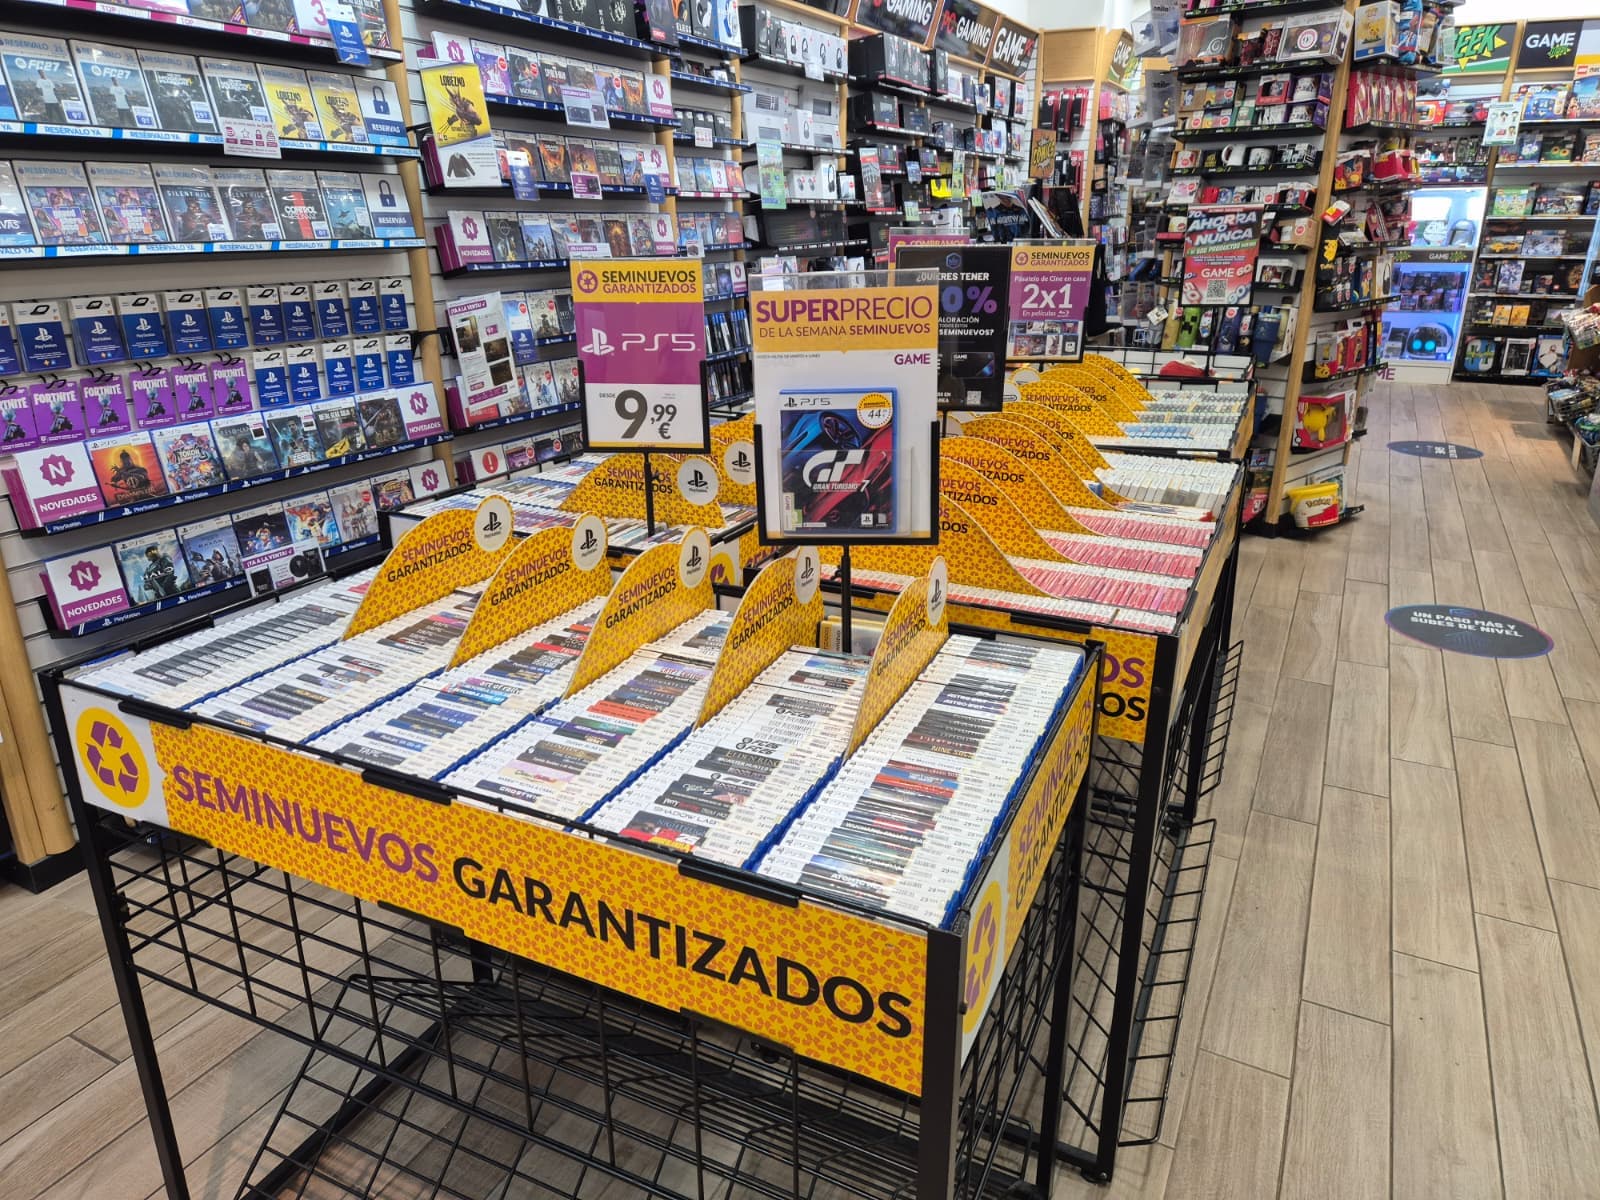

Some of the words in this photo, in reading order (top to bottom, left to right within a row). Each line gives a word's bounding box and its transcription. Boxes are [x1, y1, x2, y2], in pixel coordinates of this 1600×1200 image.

[886, 0, 933, 26] GAMING
[942, 11, 957, 33] PC
[956, 18, 992, 47] GAMING
[993, 27, 1025, 65] GAME
[1455, 25, 1502, 59] EEK
[1526, 32, 1576, 48] GAME
[27, 59, 61, 72] FC27
[102, 67, 131, 80] FC27
[440, 74, 465, 87] LOBEZNO
[92, 128, 102, 136] YA
[371, 123, 400, 134] RESERVAS
[1033, 142, 1055, 166] COMICS
[378, 216, 406, 224] RESERVAS
[1188, 212, 1257, 232] AHORRA
[1217, 224, 1228, 232] O
[1195, 228, 1253, 245] NUNCA
[461, 249, 490, 257] NOVEDADES
[1031, 251, 1090, 260] SEMINUEVOS
[602, 270, 696, 283] SEMINUEVOS
[916, 272, 958, 283] ¿QUIERES
[960, 272, 990, 281] TENER
[1201, 267, 1235, 278] GAME
[603, 283, 697, 294] GARANTIZADOS
[1021, 283, 1073, 309] 2x1
[941, 285, 998, 314] 0%
[756, 295, 933, 323] SUPERPRECIO
[759, 327, 776, 338] DE
[778, 326, 794, 337] LA
[796, 325, 848, 337] SEMANA
[849, 323, 931, 336] SEMINUEVOS
[939, 328, 995, 336] SEMINUEVOS?
[621, 332, 696, 352] PS5
[894, 353, 931, 366] GAME
[175, 372, 208, 386] FORTNITE
[214, 366, 246, 379] FORTNITE
[84, 383, 122, 398] FORTNITE
[133, 377, 169, 391] FORTNITE
[34, 389, 77, 404] FORTNITE
[800, 397, 831, 406] PS5
[1025, 393, 1079, 403] SEMINUEVOS
[409, 422, 441, 433] NOVEDADES
[49, 461, 67, 480] N
[594, 477, 673, 494] GARANTIZDOS
[831, 482, 858, 490] TURISMO
[860, 480, 870, 492] 7
[40, 492, 98, 513] NOVEDADES
[184, 491, 209, 502] PlayStation
[134, 502, 160, 513] PlayStation
[53, 521, 81, 530] PlayStation
[401, 527, 470, 563] SEMINUEVOS
[387, 540, 473, 583] GARANTIZADOS
[504, 548, 569, 584] SEMINUEVOS
[76, 566, 94, 585] N
[141, 566, 173, 581] HALO
[491, 560, 570, 606] GARANTIZADOS
[618, 565, 676, 608] SEMINUEVOS
[188, 589, 211, 600] PlayStation
[743, 580, 792, 624] SEMINUEVOS
[67, 594, 122, 618] NOVEDADES
[605, 580, 677, 630] GARANTIZADOS
[114, 612, 140, 623] PlayStation
[732, 597, 794, 650] GARANTIZADOS
[884, 600, 927, 649] SEMINUEVOS
[1412, 611, 1433, 619] UN
[1435, 613, 1470, 625] PASO
[1474, 617, 1503, 629] MÁS
[1410, 616, 1455, 628] SUBES
[1458, 623, 1477, 631] DE
[1480, 626, 1524, 638] NIVEL
[875, 618, 927, 676] GARANTIZADOS
[746, 746, 776, 755] FC26
[752, 739, 781, 749] FC26
[1019, 687, 1094, 870] SEMINUEVOS
[654, 806, 696, 820] SHADOW
[1015, 723, 1091, 912] GARANTIZADOS
[171, 763, 441, 884] SEMINUEVOS
[452, 856, 912, 1039] GARANTIZADOS
